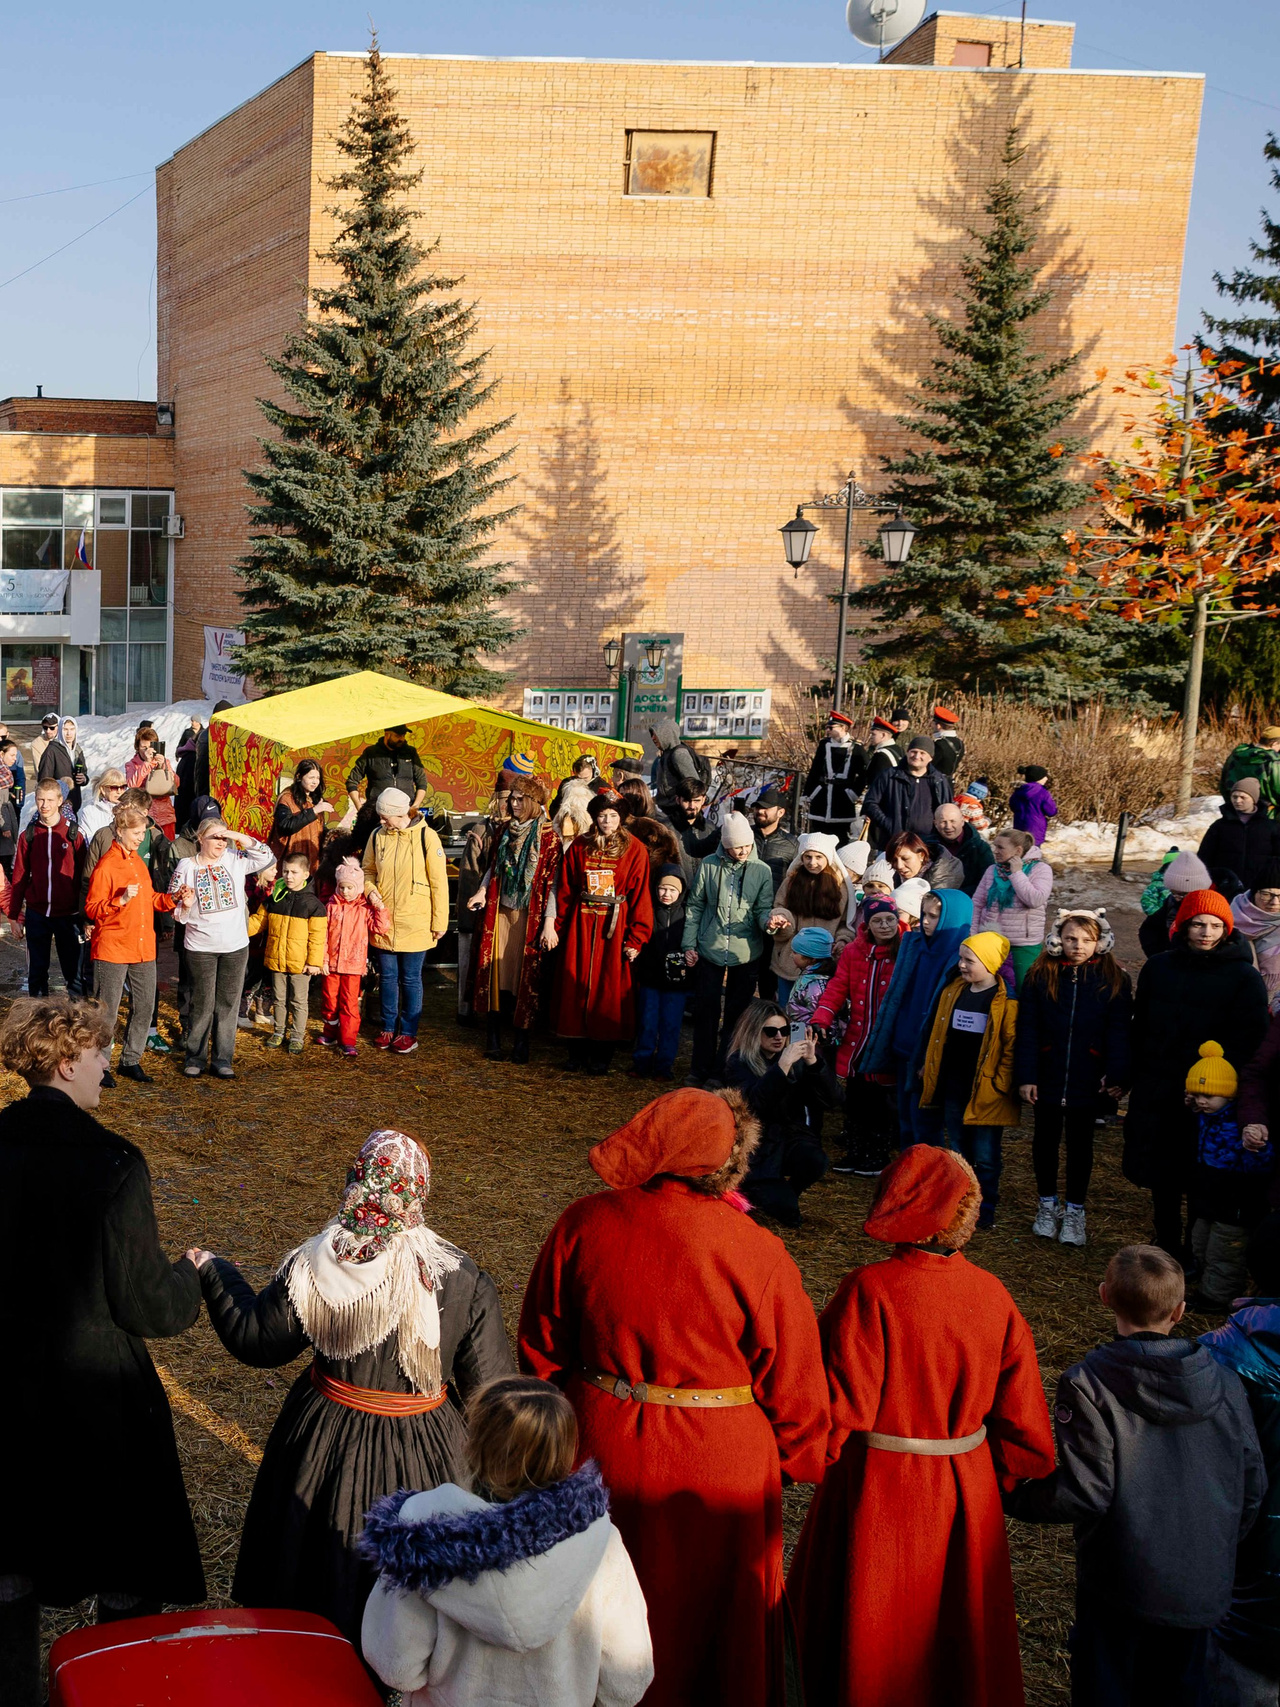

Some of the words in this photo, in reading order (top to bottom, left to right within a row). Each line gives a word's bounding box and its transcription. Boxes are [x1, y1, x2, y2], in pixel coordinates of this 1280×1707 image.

[6, 578, 15, 591] 5
[634, 694, 668, 703] ДОСКА
[634, 703, 667, 713] ПОЧЁТА
